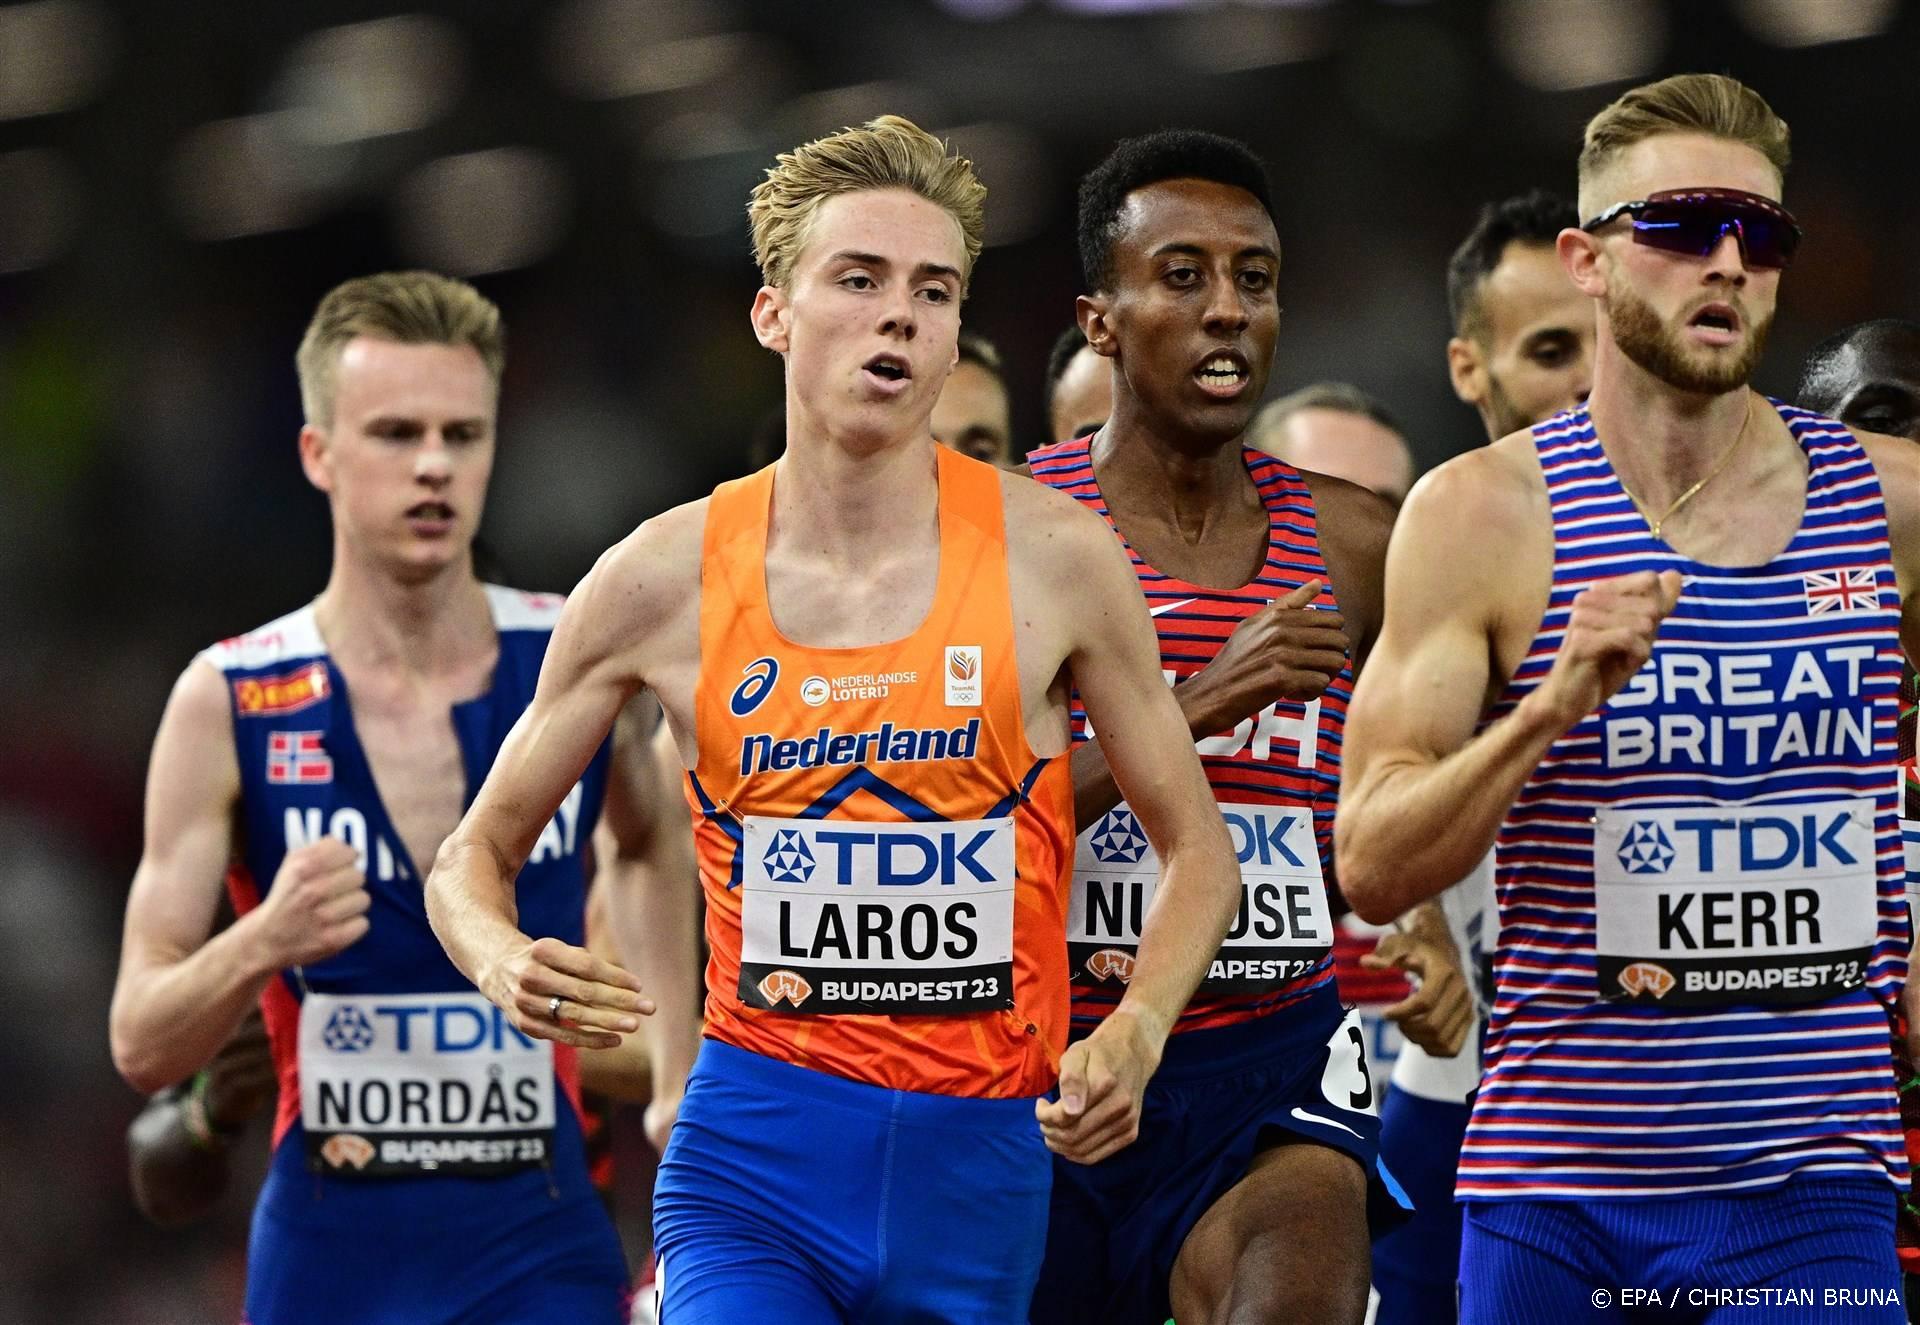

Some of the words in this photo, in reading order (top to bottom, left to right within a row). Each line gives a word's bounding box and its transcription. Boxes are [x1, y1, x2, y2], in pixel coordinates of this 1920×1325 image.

[832, 672, 917, 688] NEDERLANDSE
[832, 685, 889, 701] LOTERIJ
[1607, 646, 1875, 708] GREAT
[740, 718, 982, 776] Nederland
[1606, 707, 1872, 768] BRITAIN
[815, 829, 998, 886] TDK
[1222, 813, 1305, 867] DK
[1674, 811, 1859, 873] TDK
[779, 900, 978, 961] LAROS
[1657, 888, 1822, 950] KERR
[821, 980, 969, 1001] BUDAPEST
[971, 977, 998, 998] 23
[1206, 960, 1290, 979] APEST
[1685, 964, 1832, 991] BUDAPEST
[1833, 961, 1859, 983] 23
[375, 1005, 537, 1052] TDK
[318, 1063, 540, 1125] NORDÅS
[1347, 1026, 1372, 1109] 3
[381, 1139, 515, 1162] BUDAPEST
[517, 1138, 545, 1160] 23
